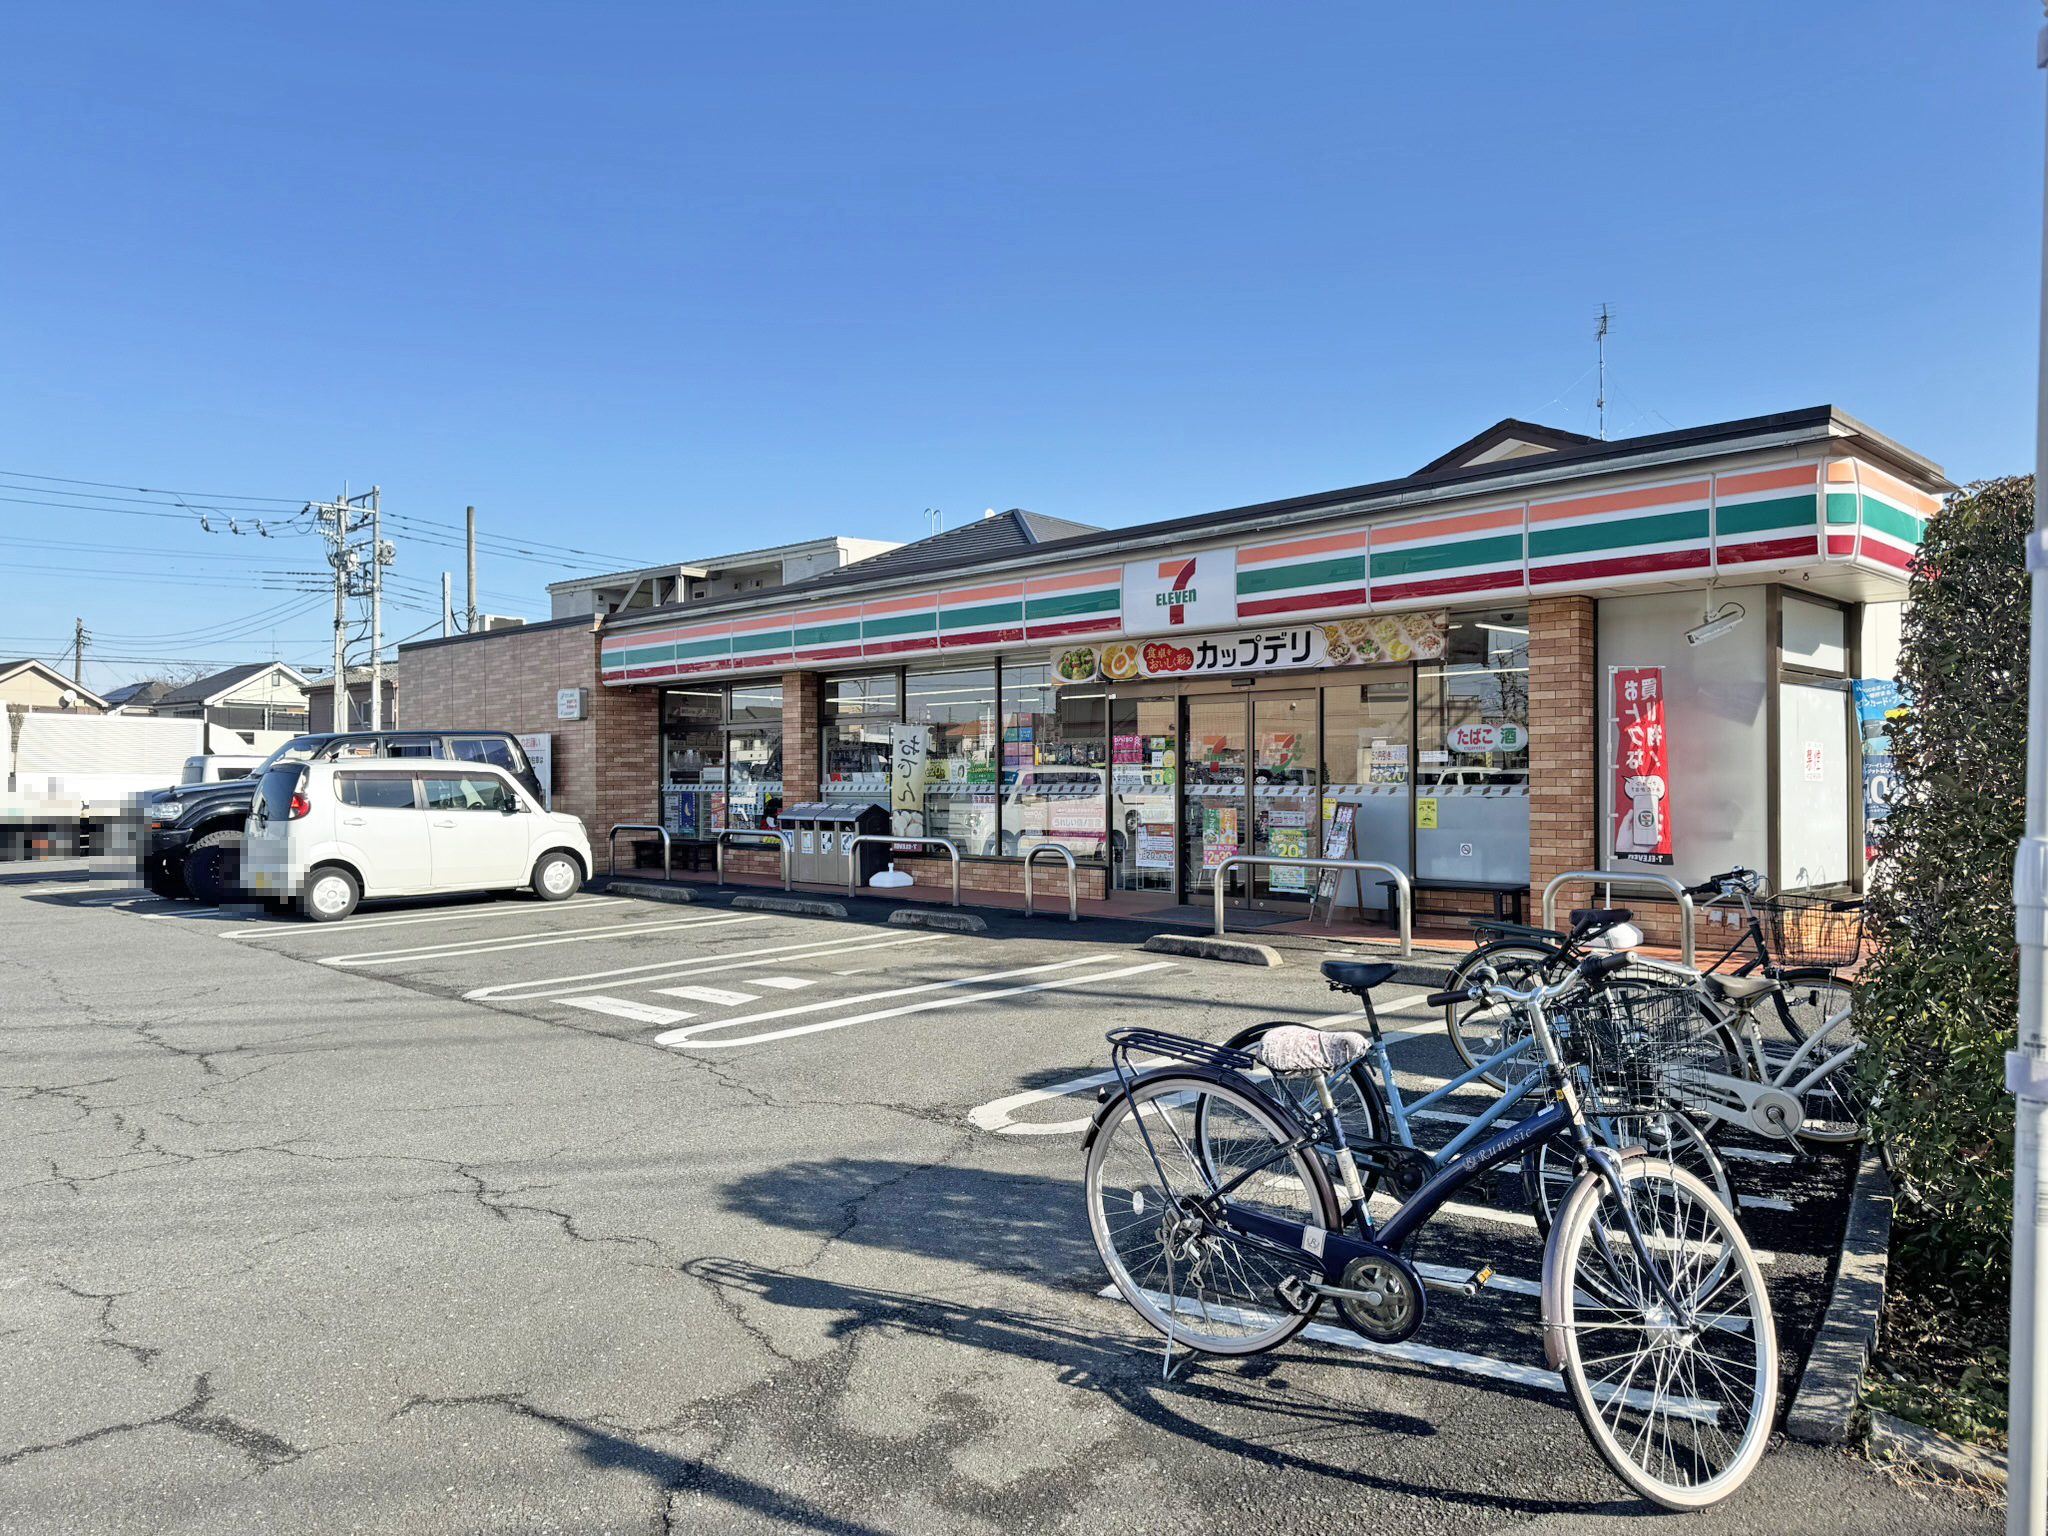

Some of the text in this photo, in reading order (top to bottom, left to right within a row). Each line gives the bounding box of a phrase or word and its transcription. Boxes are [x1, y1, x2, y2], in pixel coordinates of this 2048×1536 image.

[1196, 630, 1311, 669] カップデリ
[1149, 653, 1192, 670] おいしく彩る
[1457, 728, 1494, 745] たばこ
[1500, 727, 1517, 744] 酒
